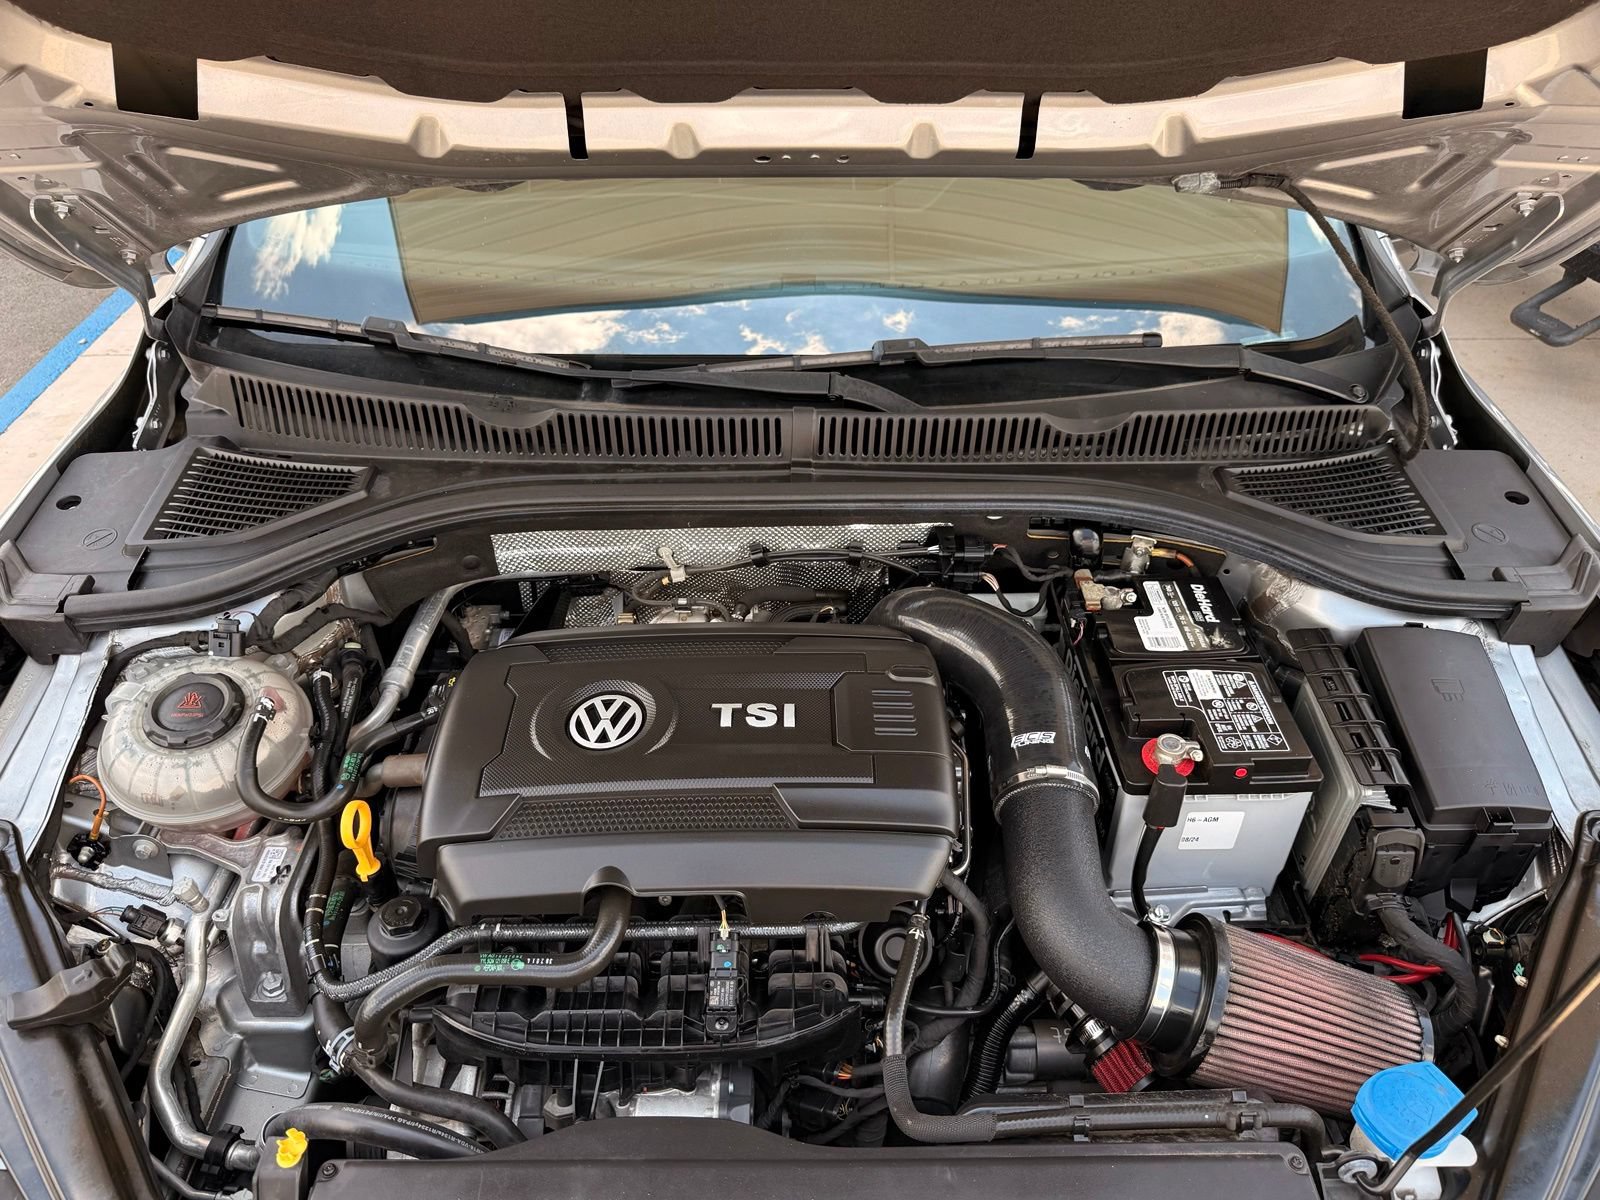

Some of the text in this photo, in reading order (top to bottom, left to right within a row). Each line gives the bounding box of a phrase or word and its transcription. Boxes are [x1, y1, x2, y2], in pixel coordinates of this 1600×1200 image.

[1190, 583, 1221, 623] DieHard
[711, 702, 796, 728] TSI
[1012, 731, 1057, 744] ECS
